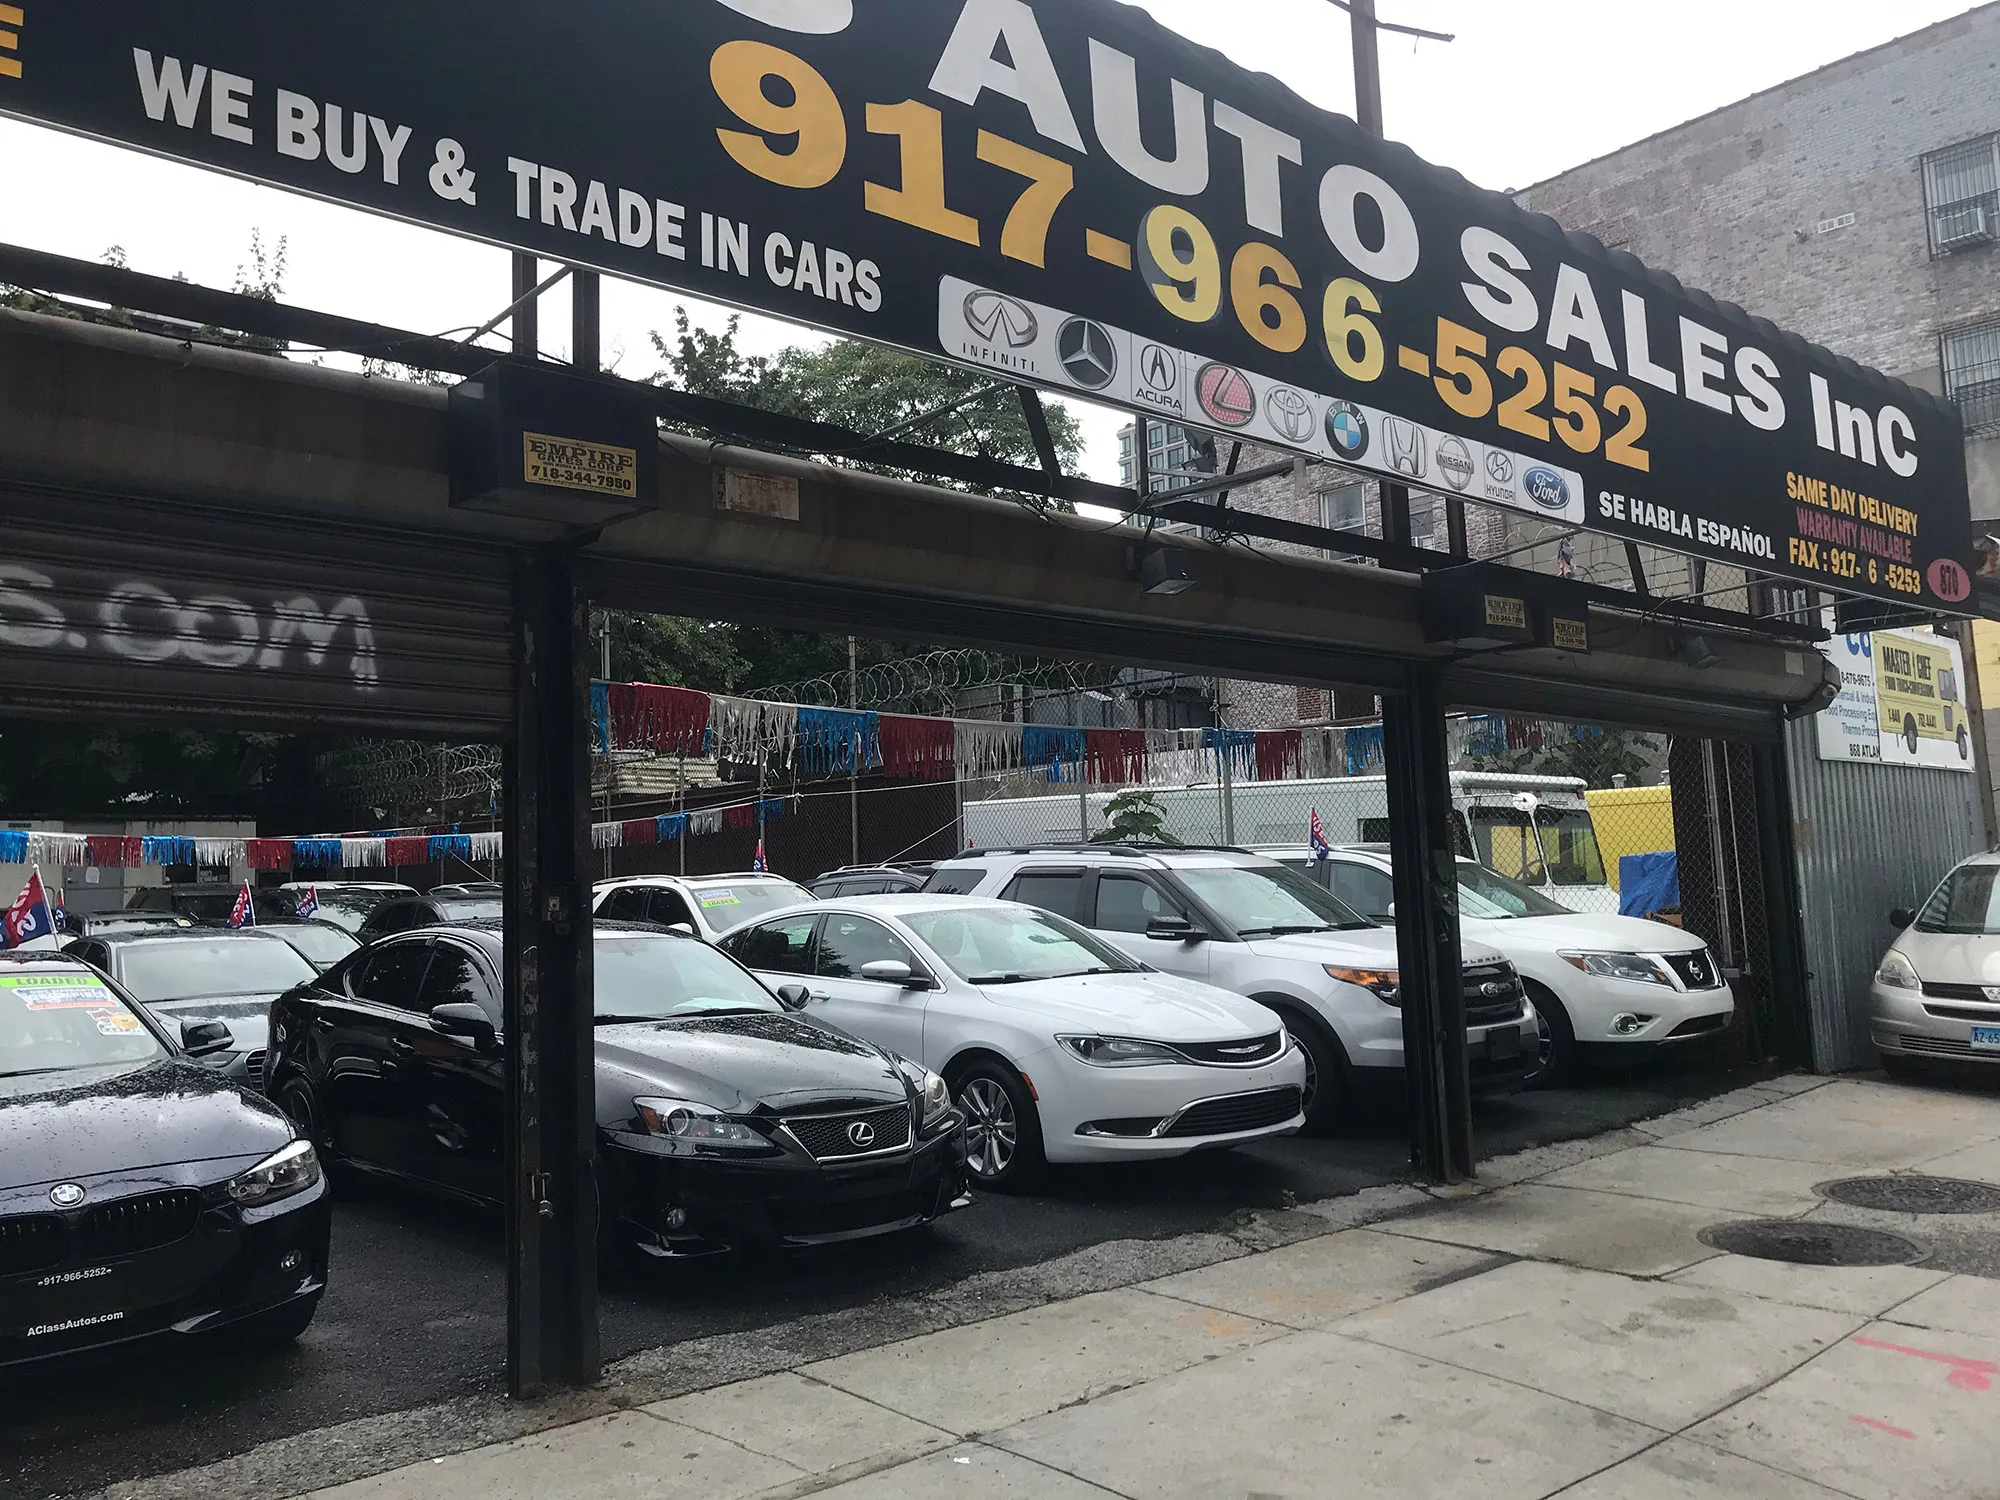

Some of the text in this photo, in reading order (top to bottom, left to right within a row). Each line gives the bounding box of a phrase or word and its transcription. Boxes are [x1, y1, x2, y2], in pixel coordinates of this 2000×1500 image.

[133, 47, 882, 313] WE BUY & TRADE IN CARS
[928, 0, 1420, 283] AUTO
[1461, 226, 1786, 431] SALES
[710, 40, 1650, 473] 917-966-5252
[962, 342, 1035, 373] INFINITI
[1135, 387, 1183, 411] ACURA
[529, 439, 633, 468] EMPIRE
[537, 452, 624, 474] GATES CORP.
[1439, 453, 1472, 471] NISSAN
[530, 464, 632, 491] 718-344-7950
[1533, 472, 1562, 504] Ford
[1786, 471, 1918, 537] SAME DAY DELIVERY
[1599, 490, 1776, 560] SE HABLA ESPAÑOL
[1796, 506, 1913, 564] WARRANTY AVAILABLE
[1789, 537, 1819, 570] FAX
[1883, 645, 1912, 676] MASTER
[16, 977, 88, 986] LOADED
[43, 1267, 107, 1285] 917-966-5252
[27, 1311, 124, 1337] AClassAutos.com
